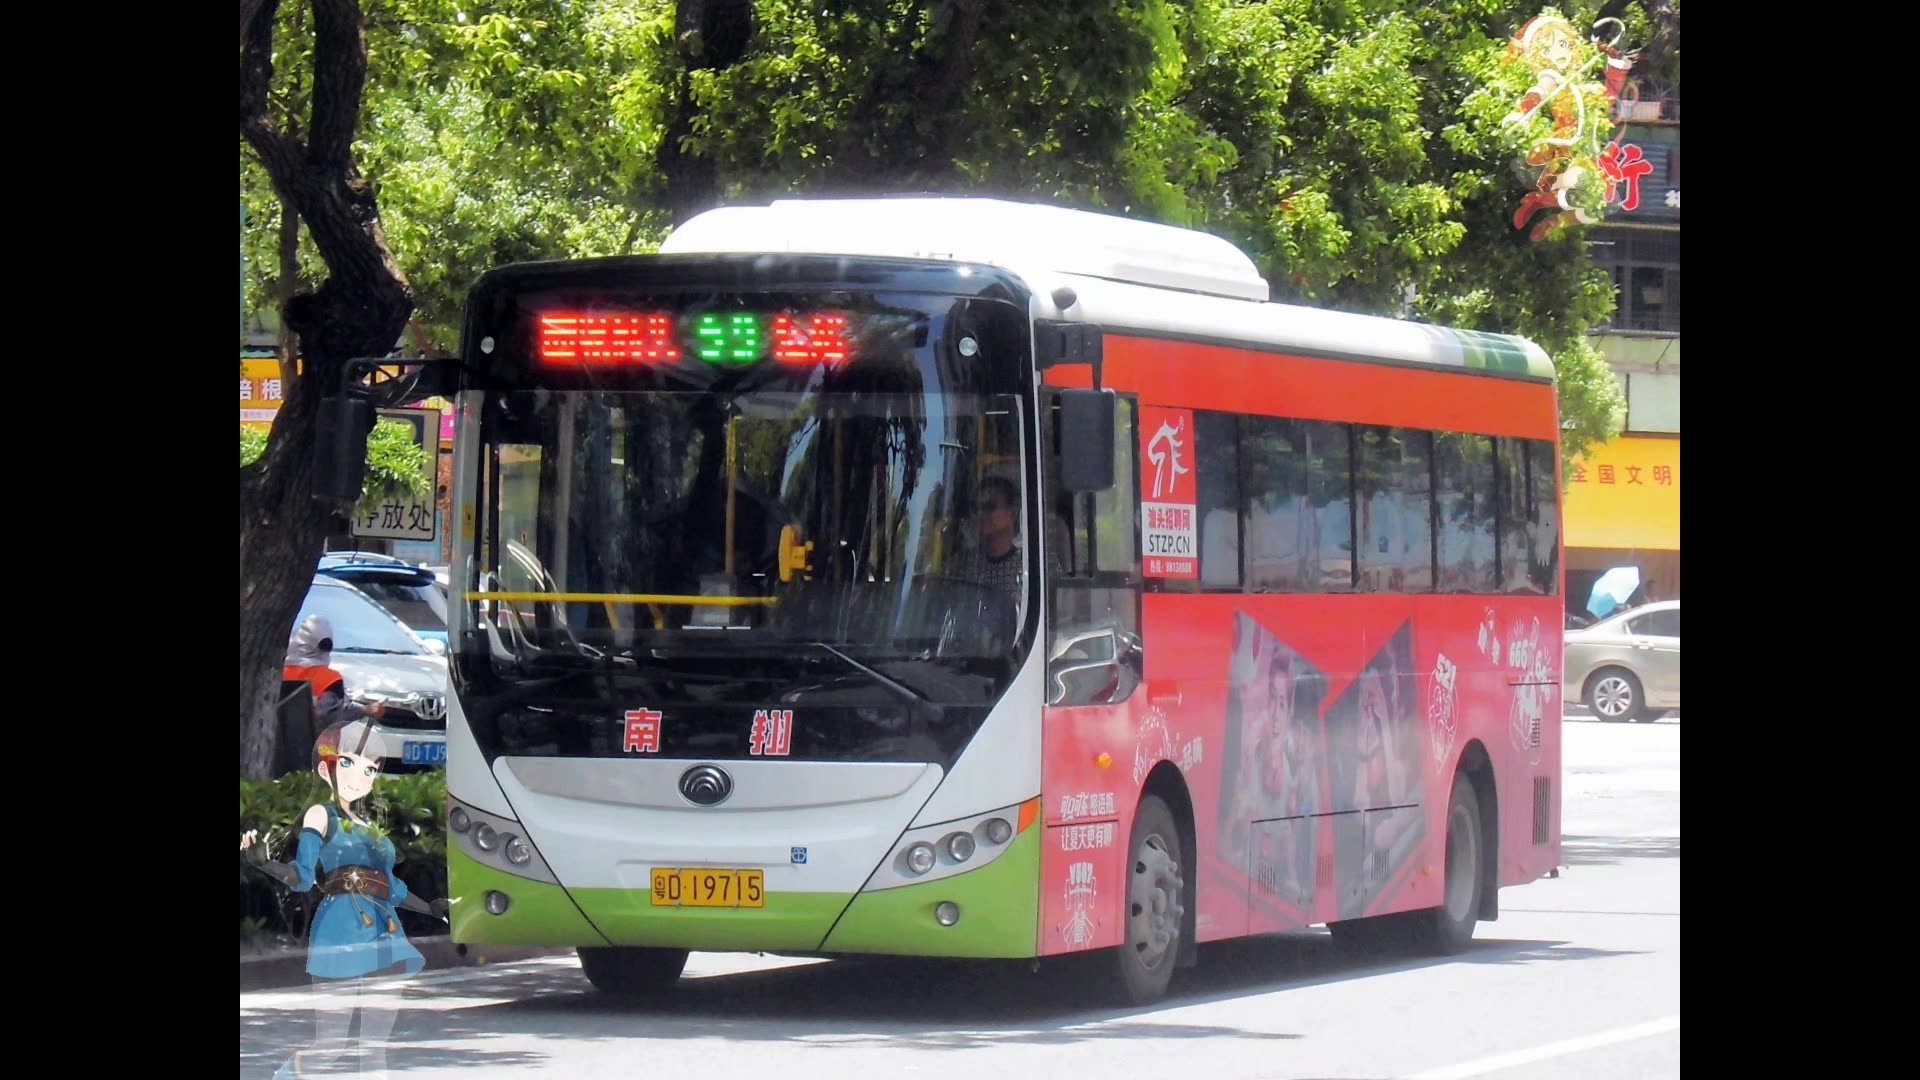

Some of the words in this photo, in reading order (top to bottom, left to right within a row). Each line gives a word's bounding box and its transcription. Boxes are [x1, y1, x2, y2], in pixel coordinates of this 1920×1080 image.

[1572, 464, 1672, 486] 全国文明
[1149, 534, 1190, 554] STZP.CN
[623, 707, 793, 755] 南翔
